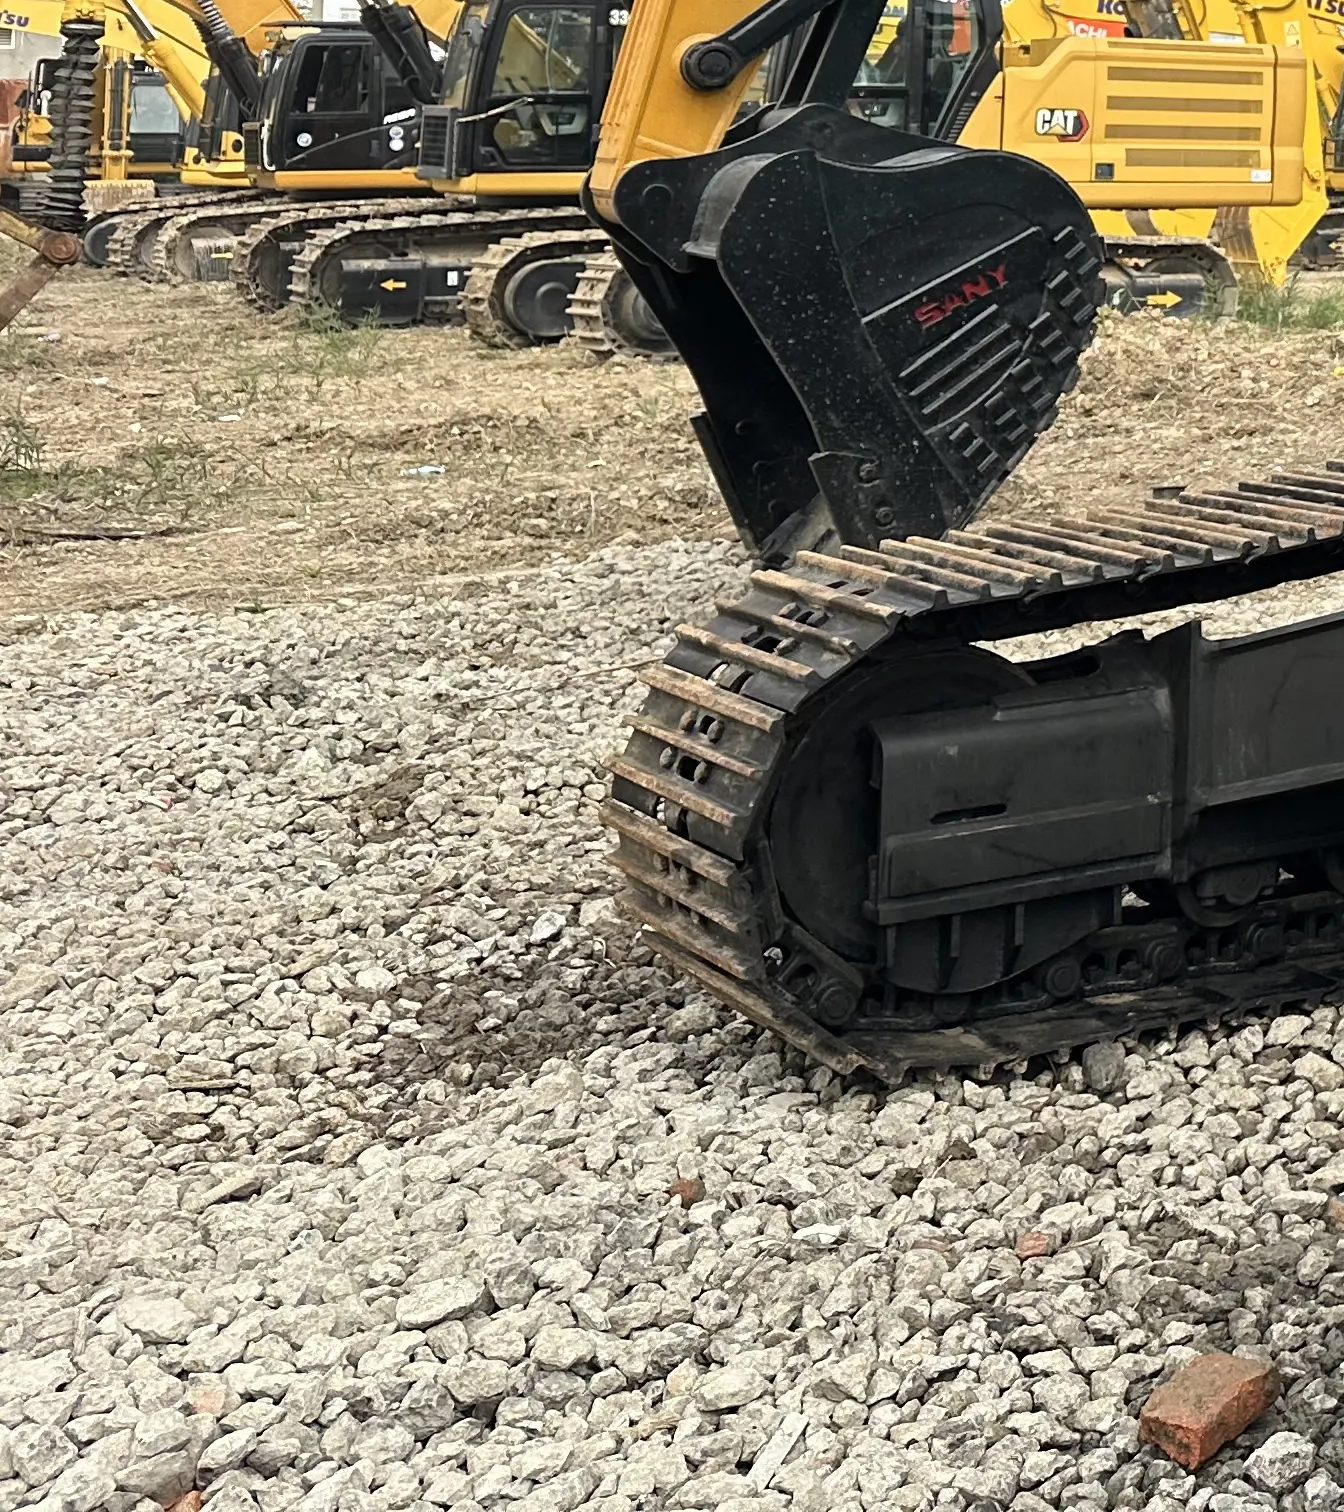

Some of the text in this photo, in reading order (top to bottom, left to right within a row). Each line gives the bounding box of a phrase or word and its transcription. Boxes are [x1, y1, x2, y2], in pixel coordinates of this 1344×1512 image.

[608, 9, 632, 26] 33
[1036, 108, 1078, 135] CAT
[914, 263, 1009, 328] SANY
